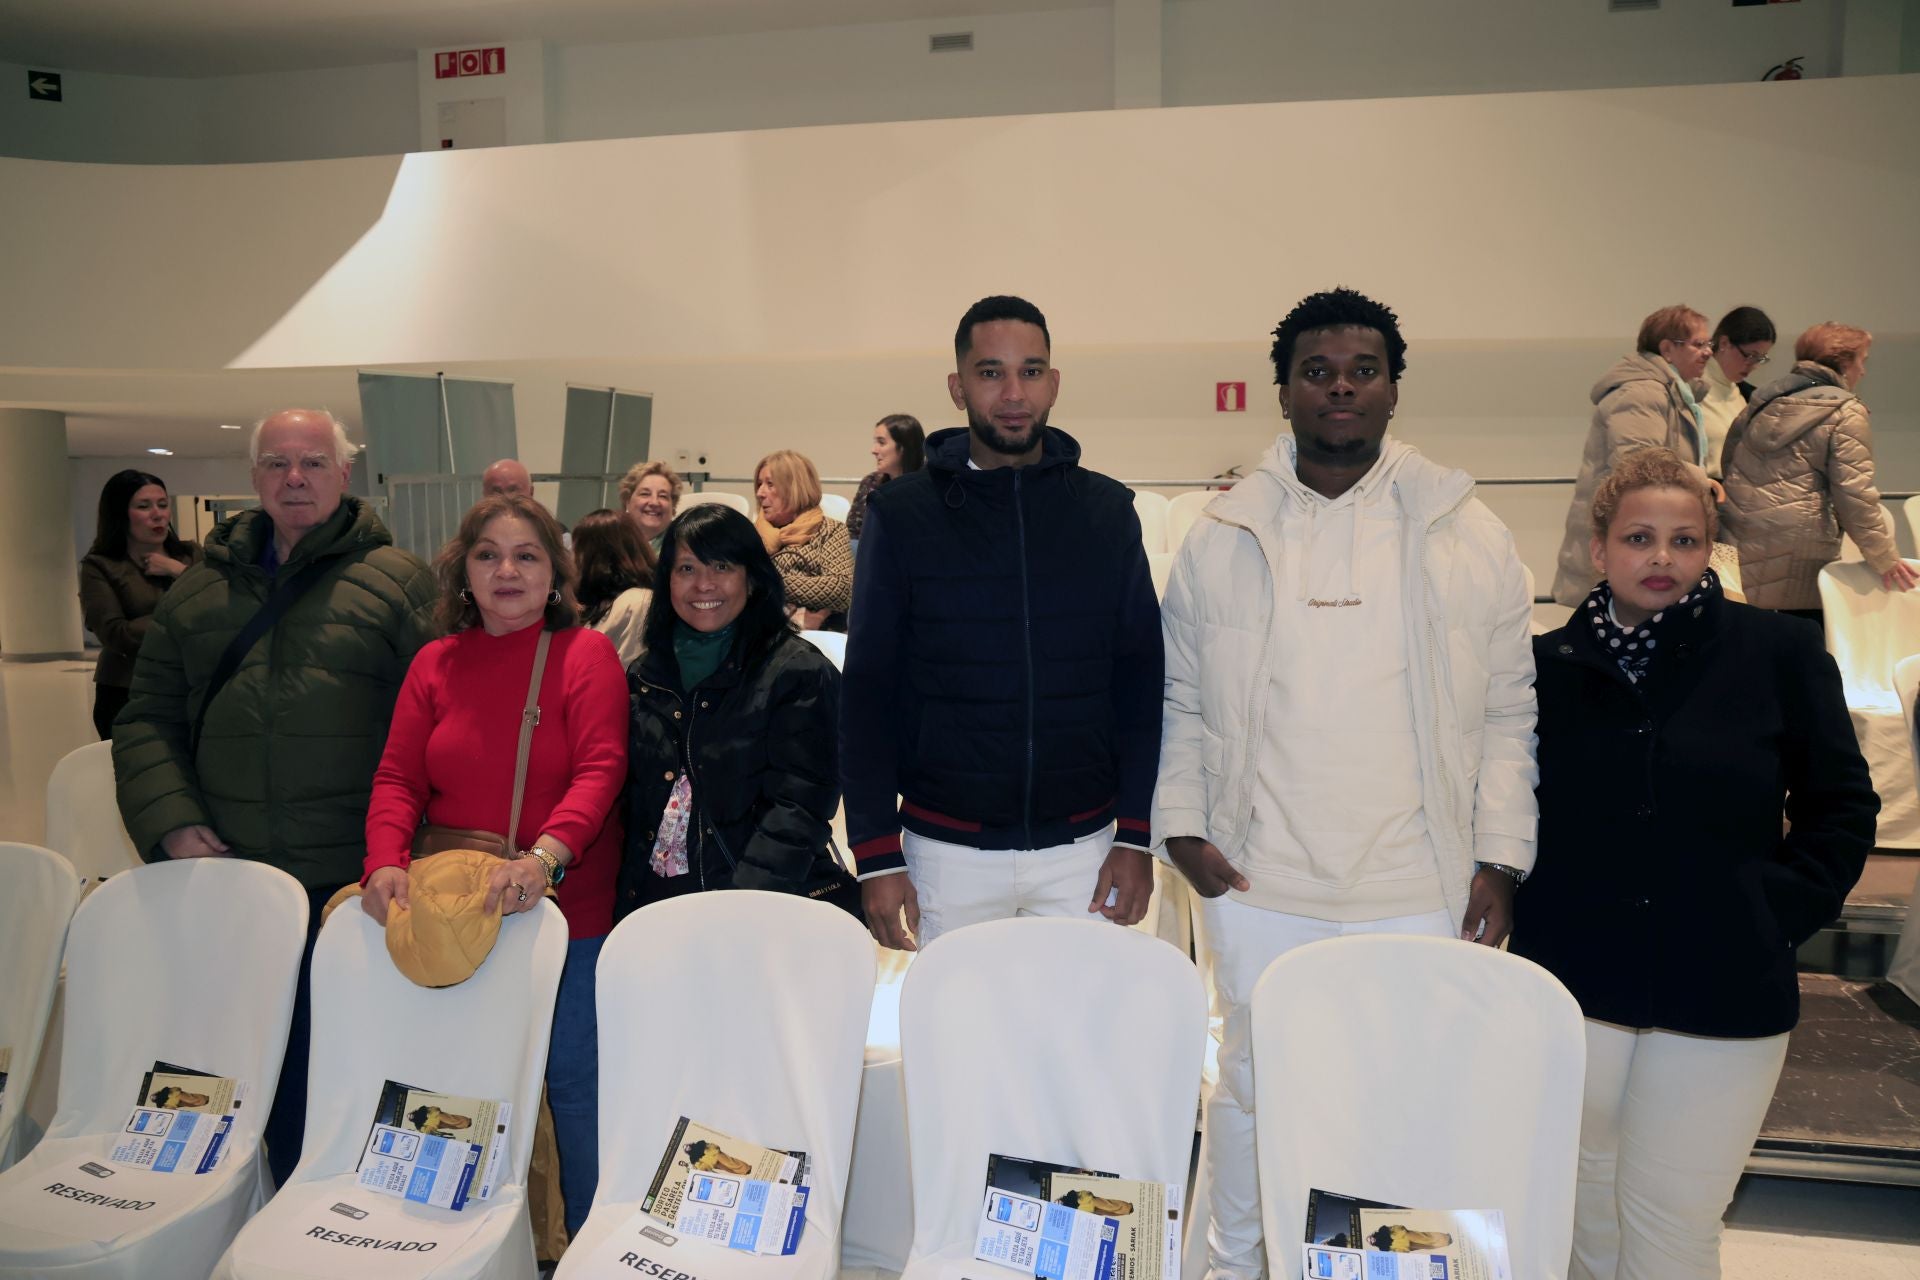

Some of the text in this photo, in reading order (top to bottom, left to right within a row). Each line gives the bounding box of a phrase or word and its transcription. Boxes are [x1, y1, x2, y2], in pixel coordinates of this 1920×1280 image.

[44, 1182, 156, 1211] RESERVADO
[654, 1187, 670, 1213] SORTEO
[660, 1181, 682, 1217] PASARELA
[306, 1226, 438, 1252] RESERVADO
[619, 1251, 697, 1280] RESER
